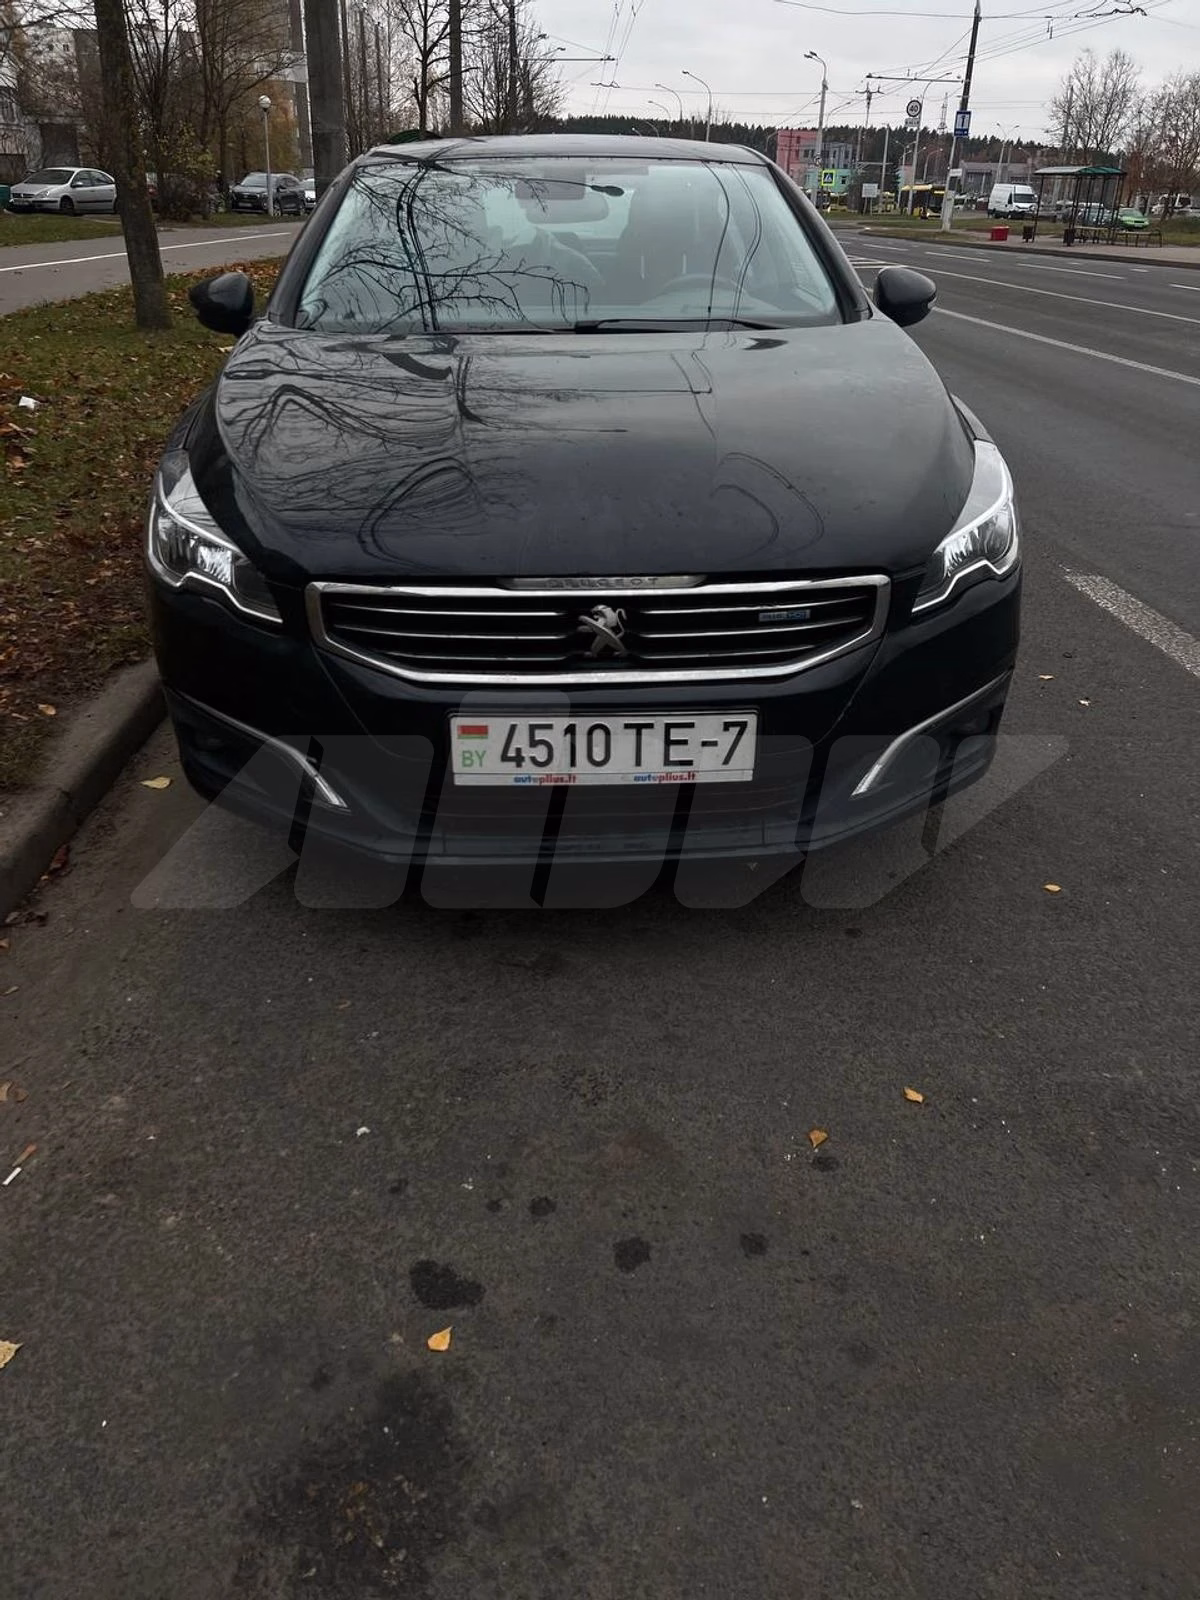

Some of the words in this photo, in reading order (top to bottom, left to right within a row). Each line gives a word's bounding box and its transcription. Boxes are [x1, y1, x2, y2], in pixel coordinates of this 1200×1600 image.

[462, 750, 487, 768] BY
[500, 723, 612, 768] 4510
[623, 720, 749, 767] TE-7
